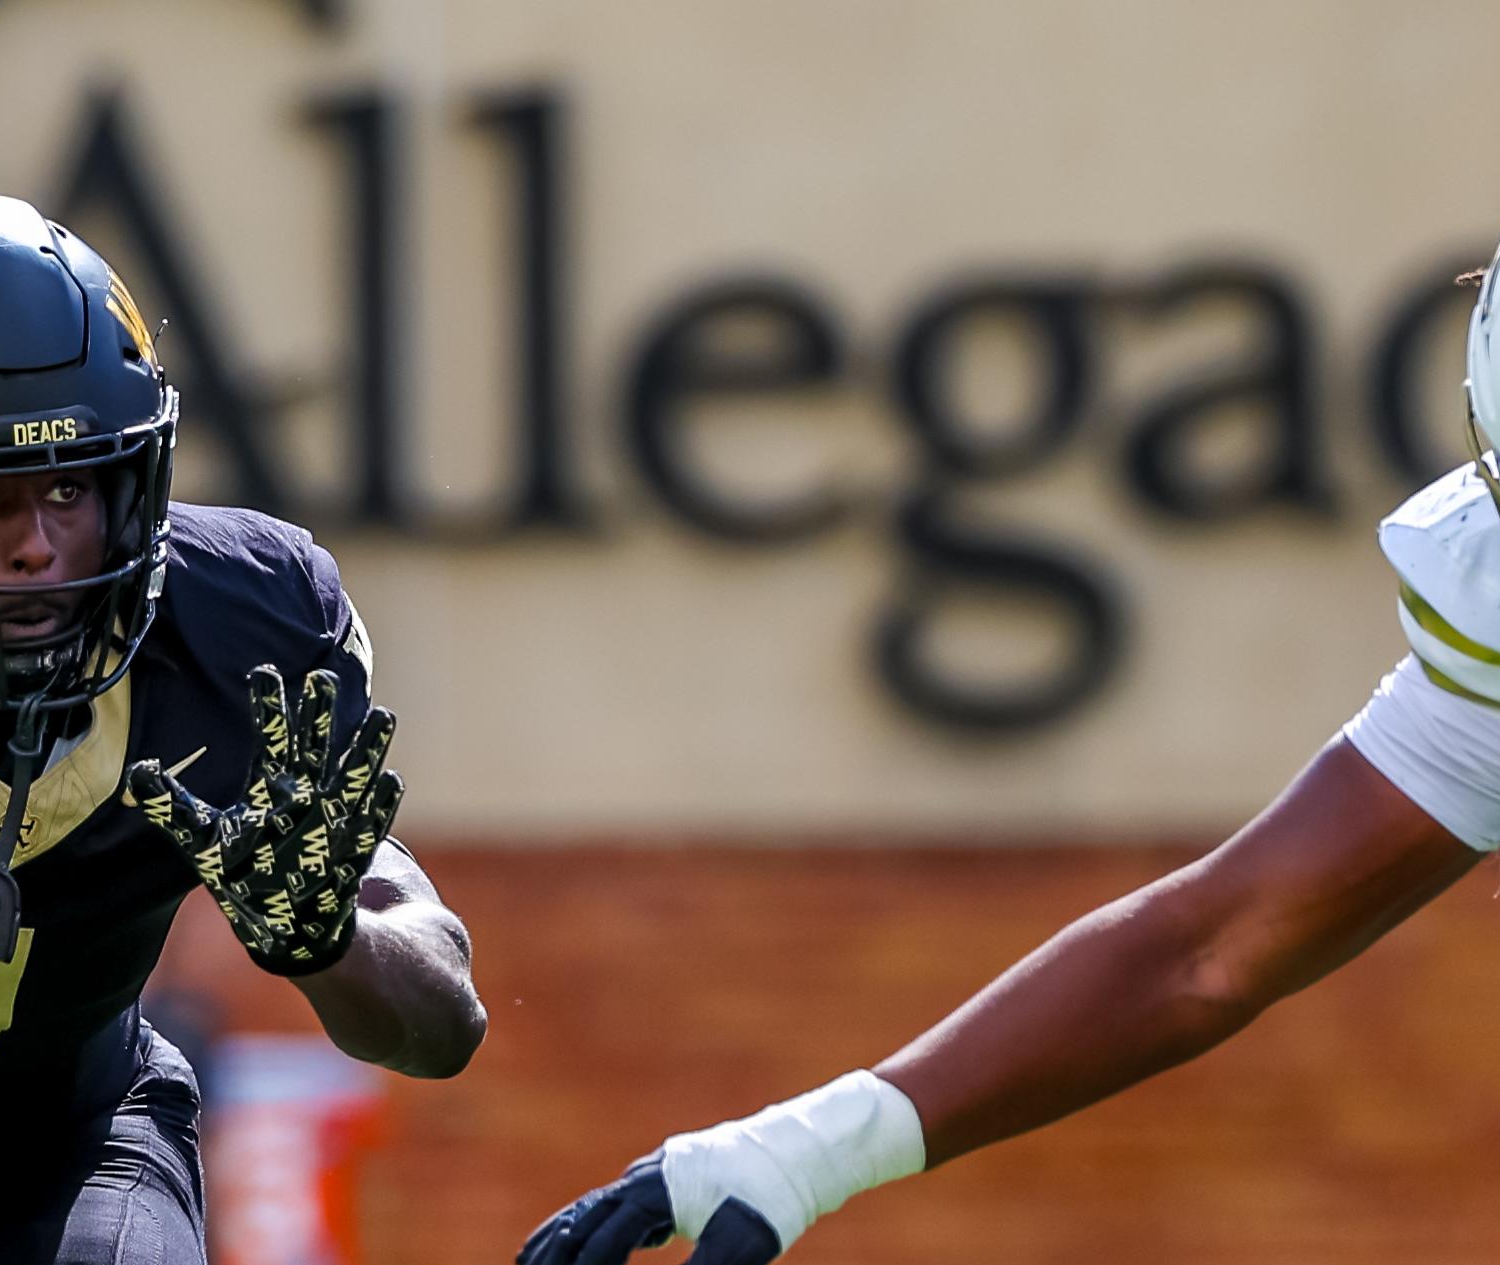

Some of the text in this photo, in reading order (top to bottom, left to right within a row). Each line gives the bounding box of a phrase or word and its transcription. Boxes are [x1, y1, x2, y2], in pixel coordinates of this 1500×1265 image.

[13, 418, 78, 446] DEACS
[291, 774, 315, 805] WF
[194, 842, 225, 890] WF
[253, 843, 276, 876] WF
[299, 824, 331, 877] WF
[263, 890, 296, 935] WF
